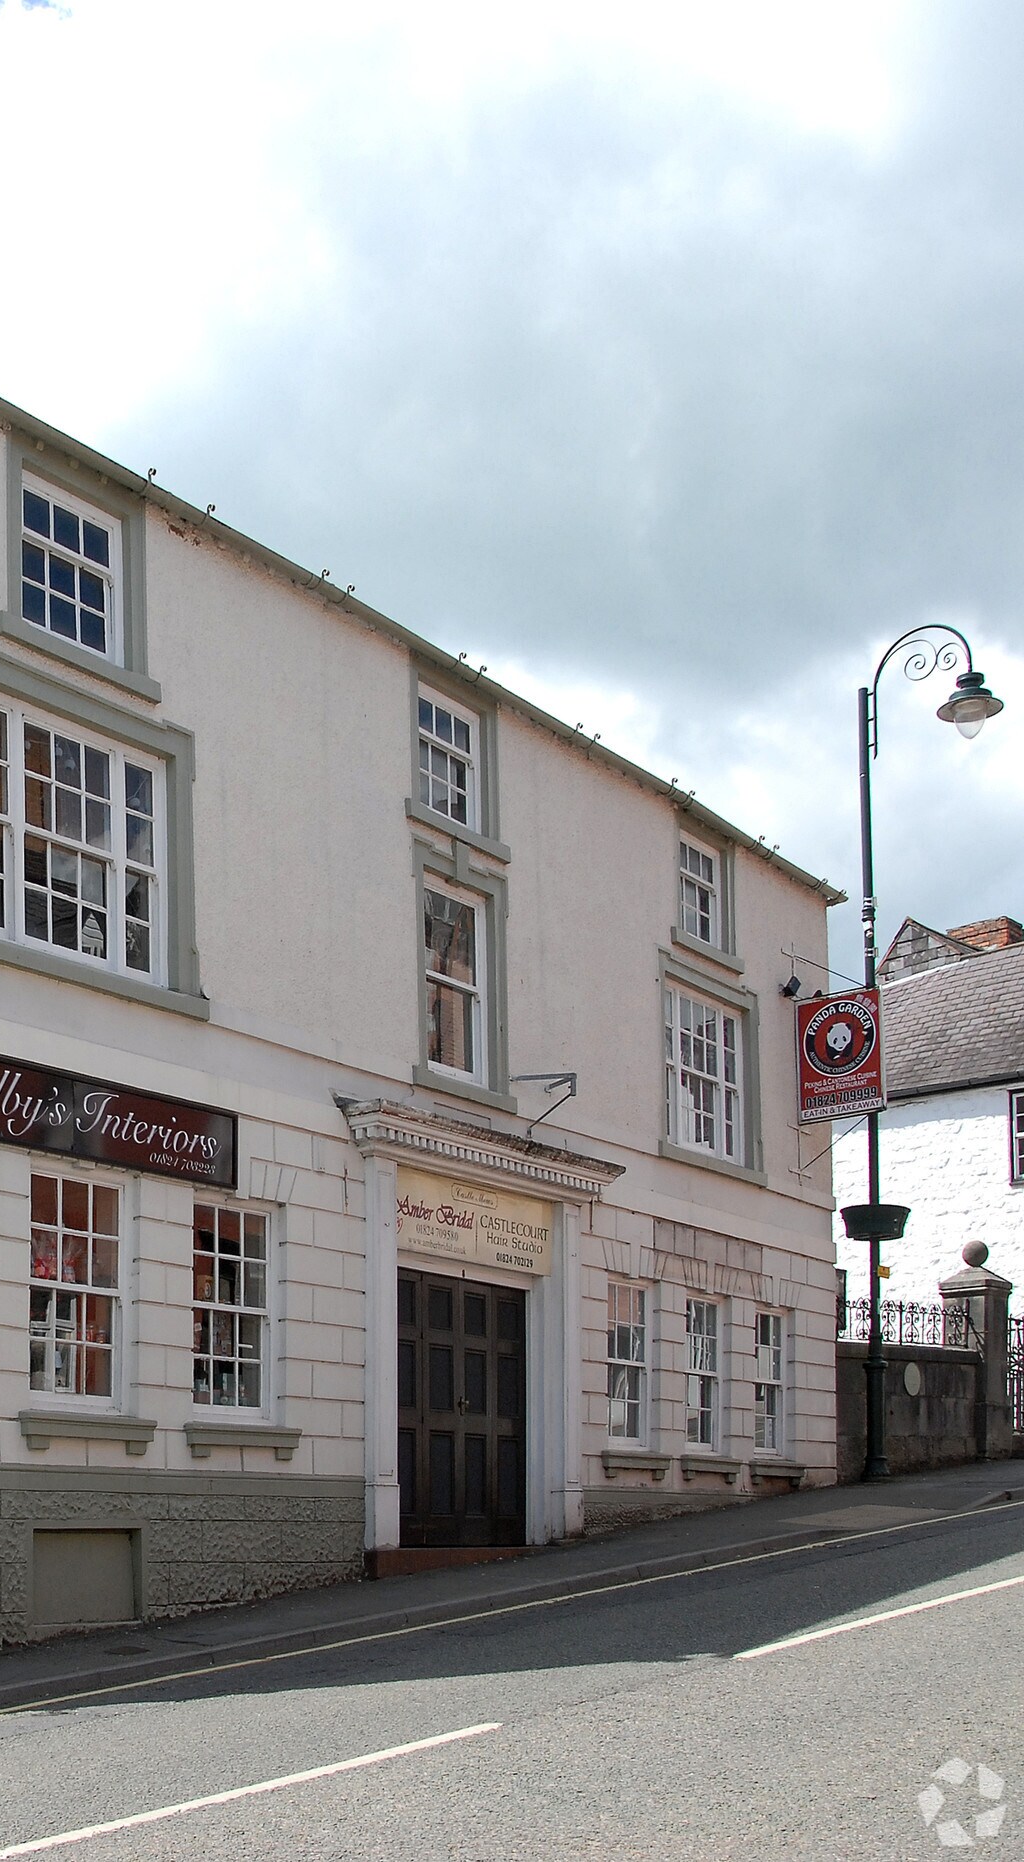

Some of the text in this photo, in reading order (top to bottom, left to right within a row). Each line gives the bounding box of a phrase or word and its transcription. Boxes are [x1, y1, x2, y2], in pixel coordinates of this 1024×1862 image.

[808, 1005, 836, 1036] PANDA
[838, 1003, 872, 1031] GARDEN
[835, 1079, 868, 1090] RESTAURANT
[806, 1086, 878, 1109] 01824 709999
[804, 1099, 881, 1118] EAT-IN & TAKEAWAY
[76, 1091, 222, 1160] Interiors
[149, 1152, 179, 1167] 01824
[397, 1194, 474, 1230] Amber Bridal
[416, 1223, 434, 1237] 01824
[479, 1214, 549, 1242] CASTLECOURT
[512, 1236, 543, 1255] Studio
